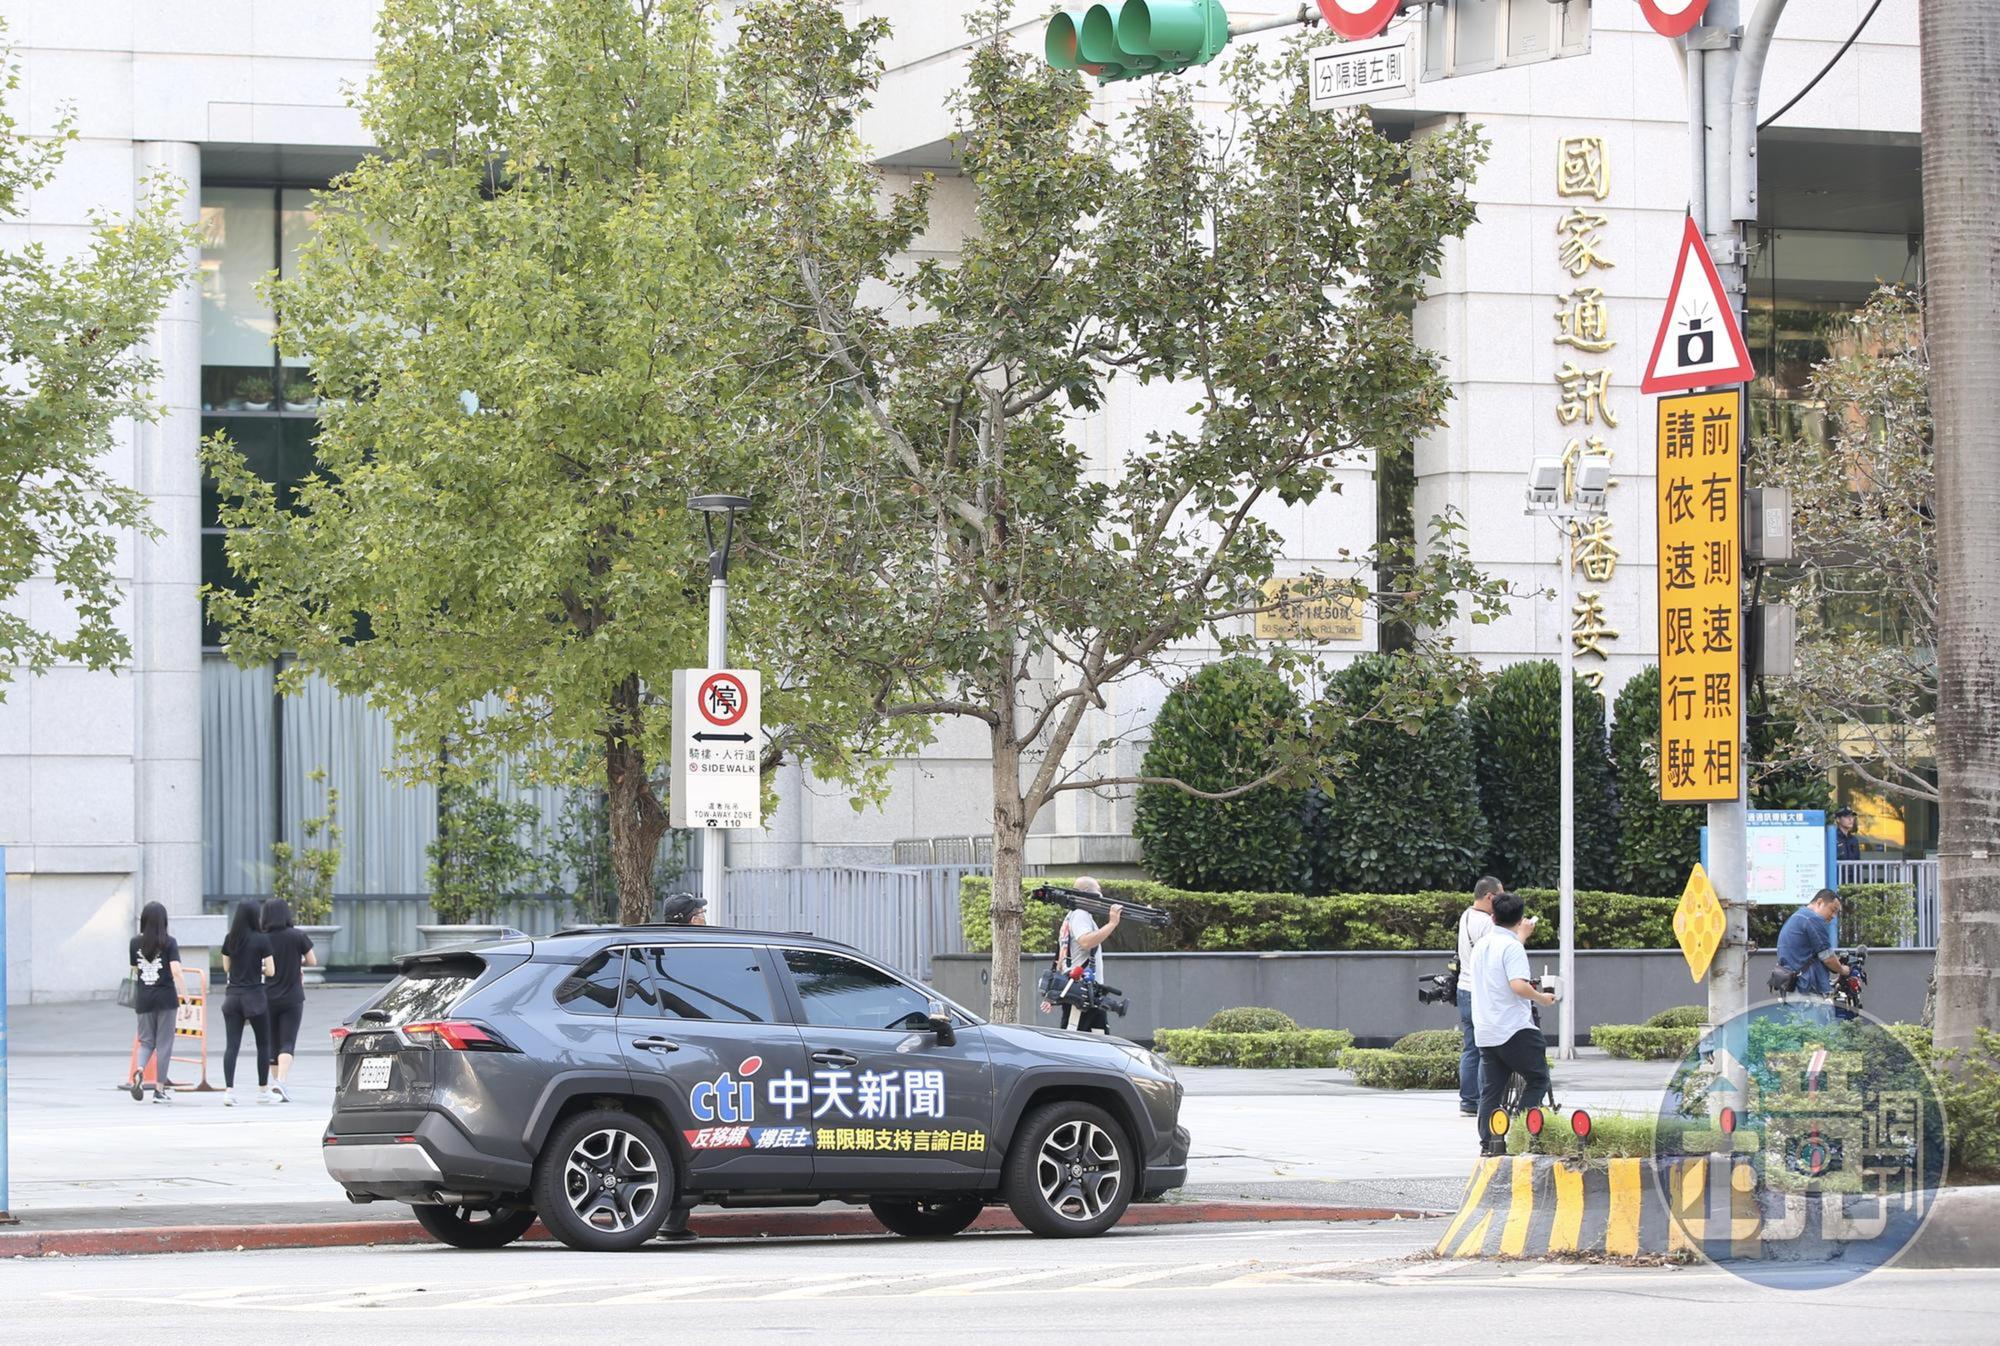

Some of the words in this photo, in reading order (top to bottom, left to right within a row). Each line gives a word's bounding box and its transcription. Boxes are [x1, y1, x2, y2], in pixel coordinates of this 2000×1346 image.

[1320, 52, 1401, 93] 分隔道左側
[1664, 411, 1697, 788] 請依速限行駛
[1701, 406, 1733, 787] 前有測速照相
[709, 685, 737, 715] 停
[701, 763, 755, 773] SIDEWALK
[724, 819, 741, 827] 110
[734, 811, 752, 819] ZONE
[689, 1055, 763, 1123] cti
[767, 1068, 946, 1121] 中天新聞
[691, 1126, 749, 1148] 反移頻
[816, 1127, 986, 1152] 無限期支持言論自由
